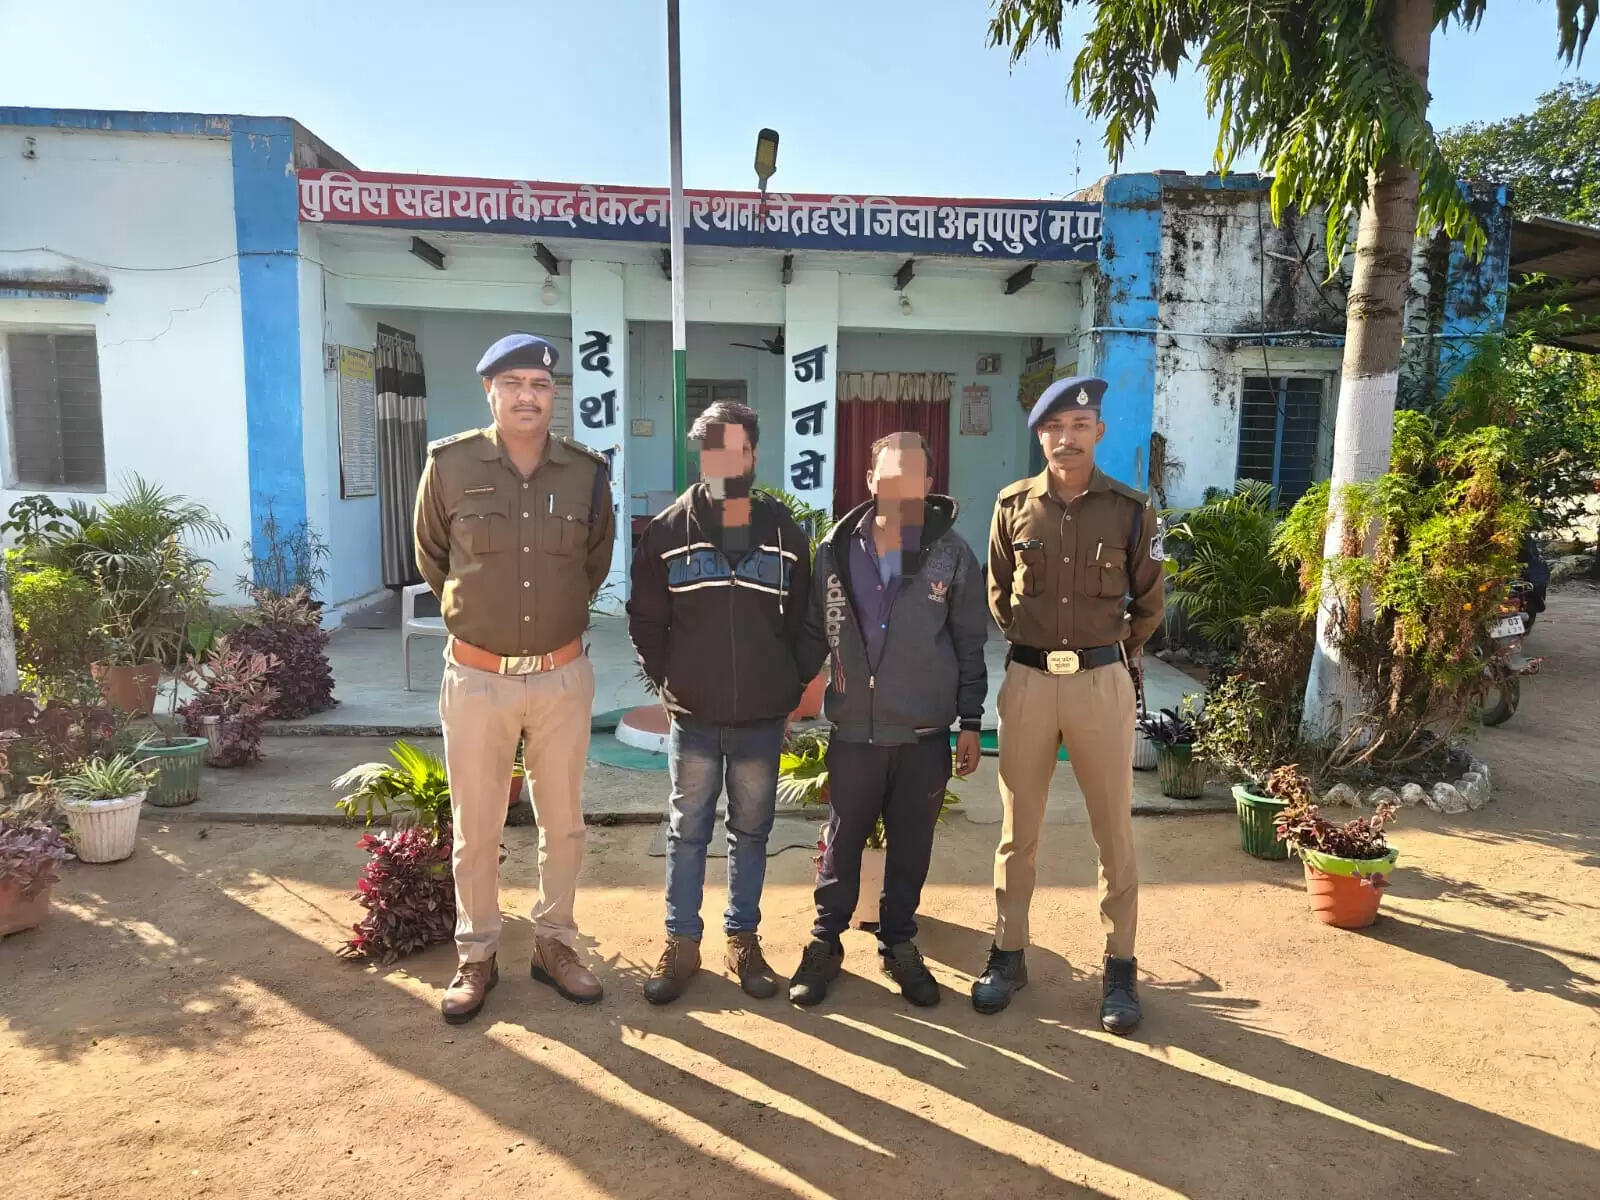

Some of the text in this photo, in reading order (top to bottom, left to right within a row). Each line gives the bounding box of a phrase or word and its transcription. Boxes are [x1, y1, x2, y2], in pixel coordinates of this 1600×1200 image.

[299, 171, 391, 222] पुलिस
[391, 183, 509, 224] सहायता
[711, 196, 760, 231] थाना
[765, 193, 860, 236] जैतहरी
[860, 195, 937, 239] जिला
[938, 206, 1039, 254] अनूपपुर
[826, 573, 846, 648] adidas
